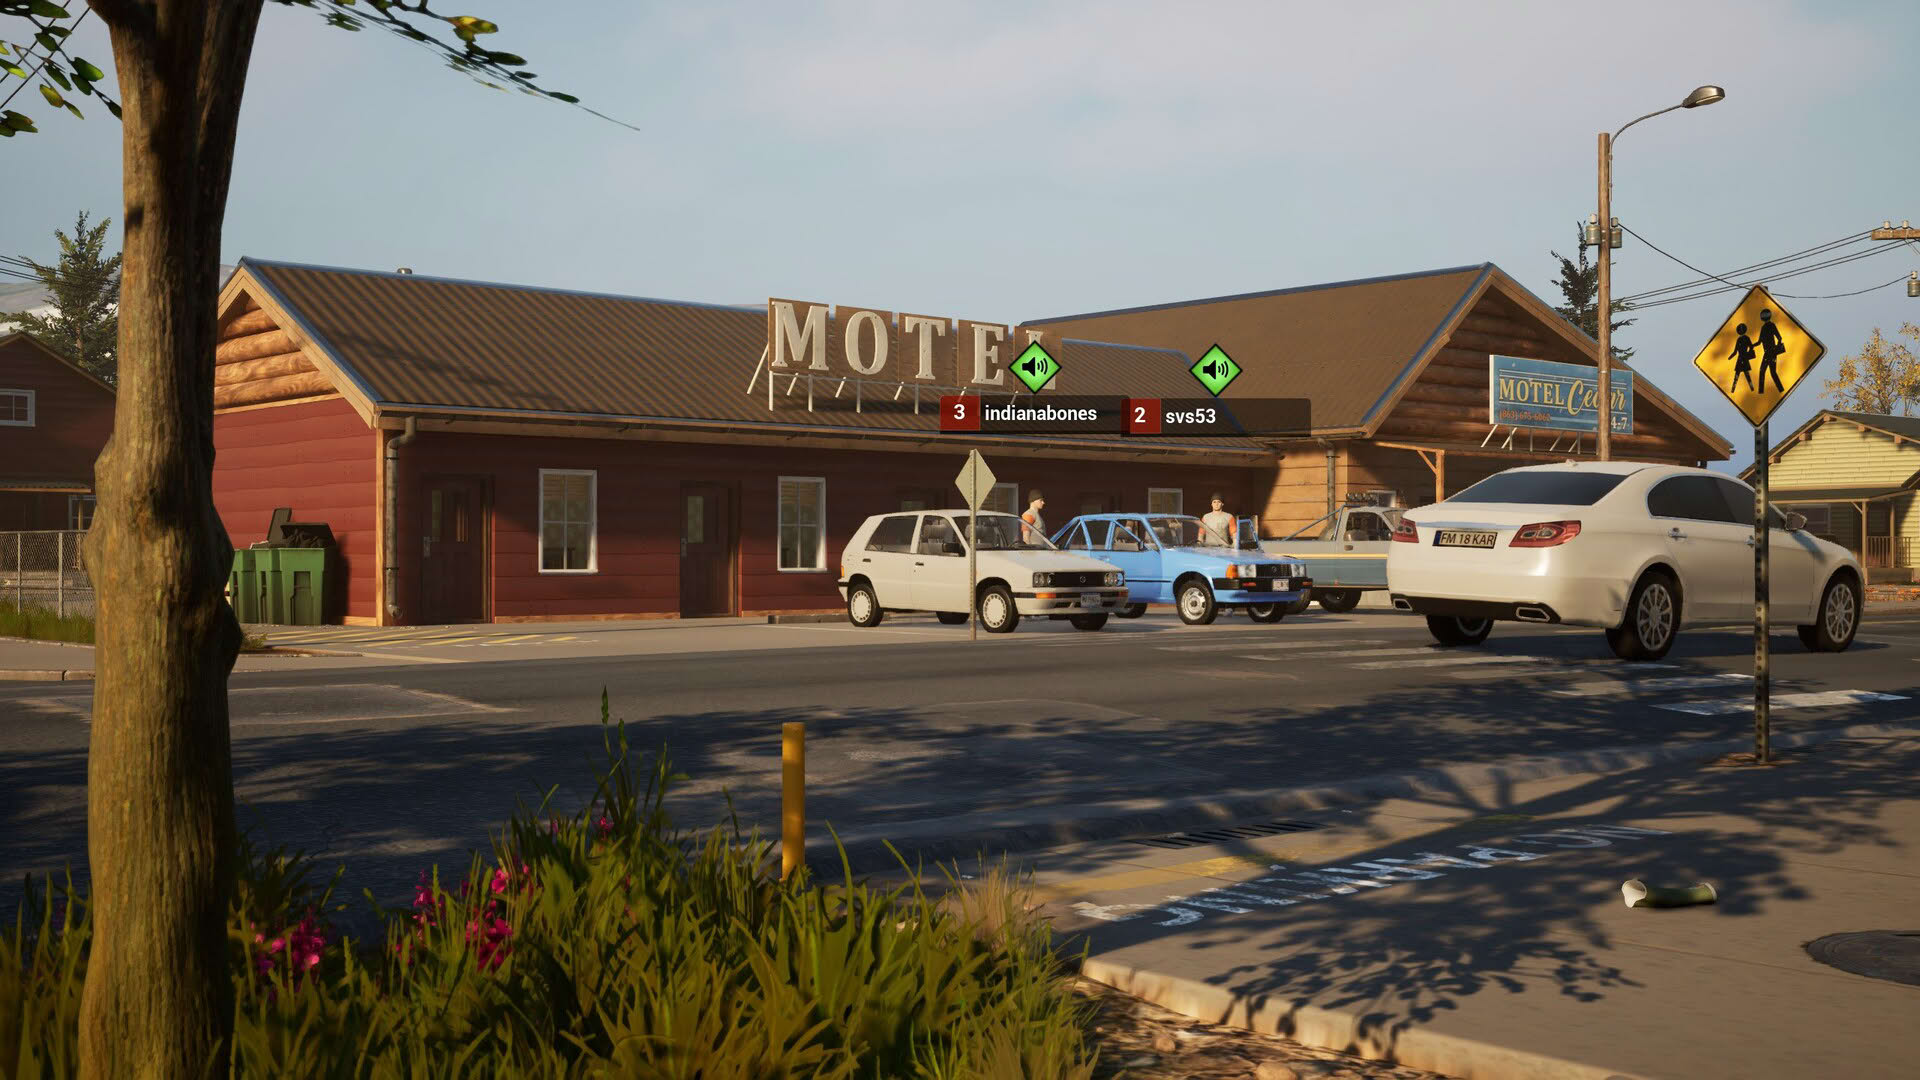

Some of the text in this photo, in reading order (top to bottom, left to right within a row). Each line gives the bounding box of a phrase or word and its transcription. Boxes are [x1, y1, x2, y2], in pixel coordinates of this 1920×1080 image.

[1499, 377, 1564, 406] MOTEL
[1440, 532, 1495, 546] FM 18 KAR
